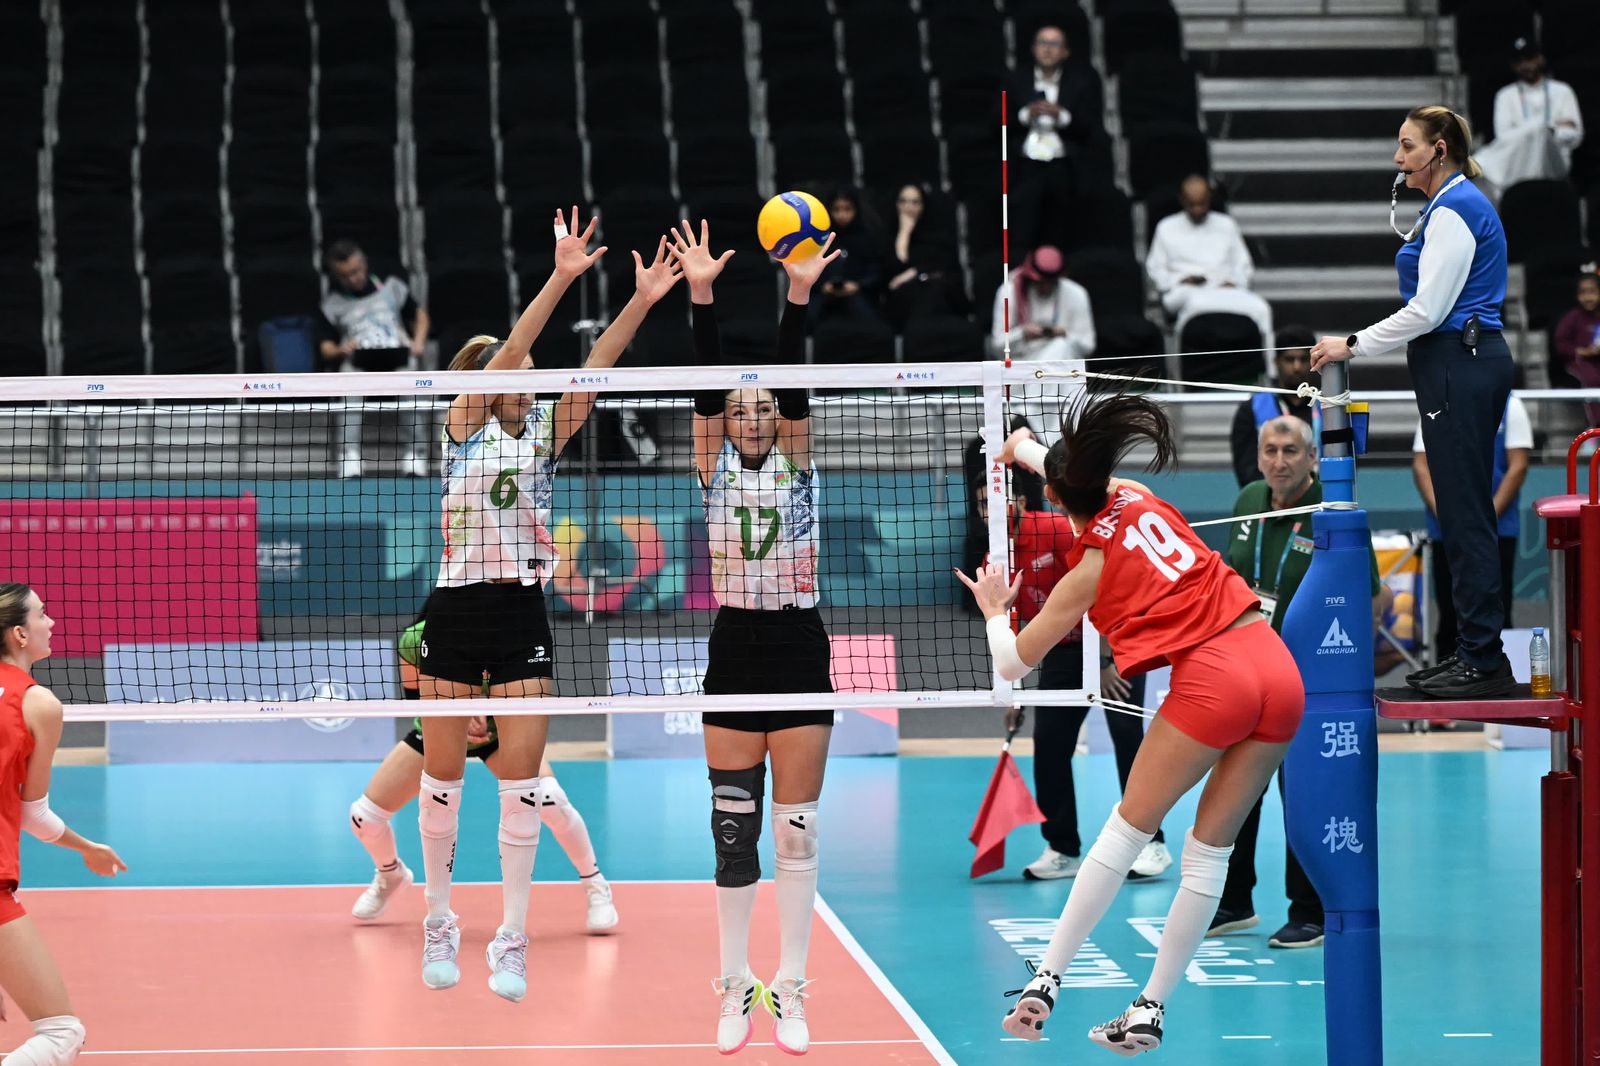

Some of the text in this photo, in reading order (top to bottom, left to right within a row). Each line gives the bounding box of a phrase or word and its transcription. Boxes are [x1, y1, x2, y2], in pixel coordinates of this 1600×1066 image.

[489, 467, 523, 510] 6
[733, 506, 783, 561] 17
[1122, 511, 1196, 582] 19
[1325, 596, 1345, 605] FIVB
[1316, 647, 1358, 655] QIANGHUAI
